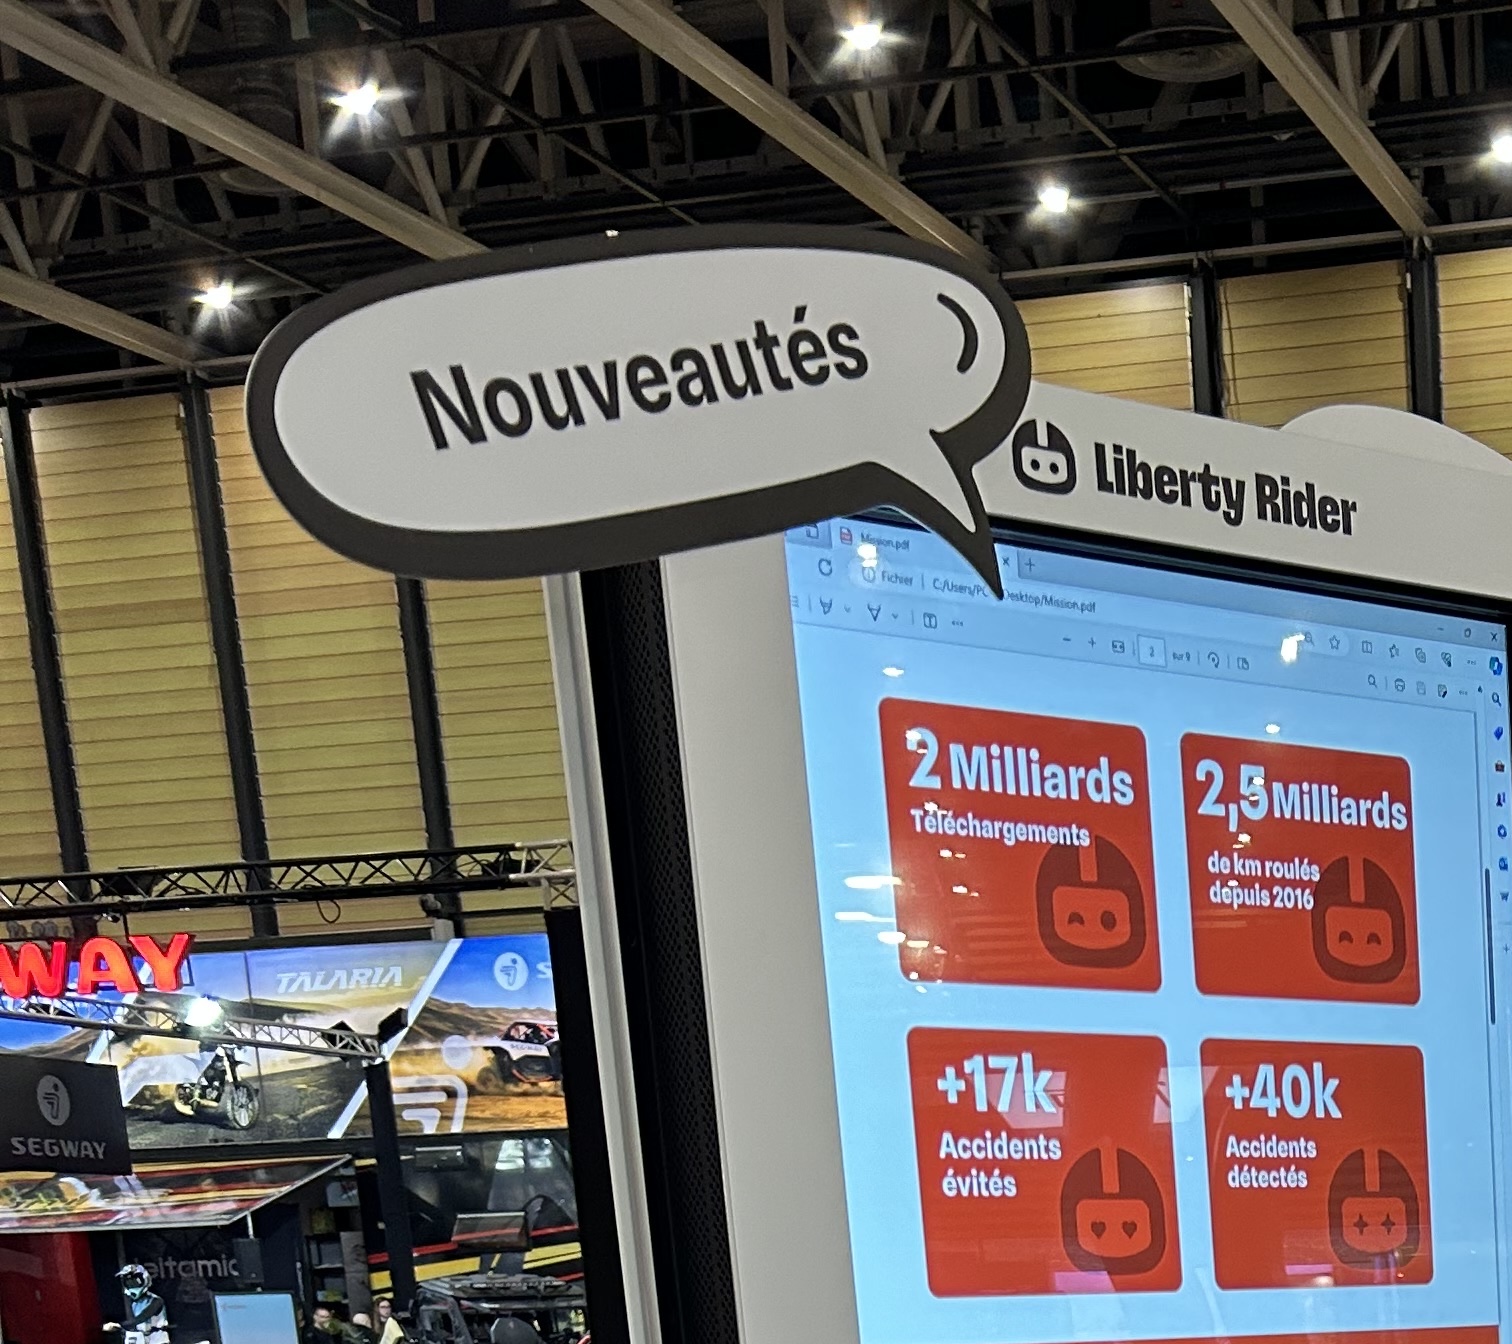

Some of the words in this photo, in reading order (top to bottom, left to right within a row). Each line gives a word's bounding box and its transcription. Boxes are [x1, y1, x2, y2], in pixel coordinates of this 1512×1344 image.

[408, 304, 870, 450] Nouveautés
[1094, 442, 1246, 527] Liberty
[1254, 472, 1357, 535] Rider
[906, 727, 942, 789] 2
[949, 744, 1135, 806] Milliards
[1196, 758, 1269, 832] 2,5
[1272, 781, 1408, 831] Milliards
[909, 806, 1091, 847] Téléchargements
[1207, 851, 1231, 874] de
[1233, 852, 1262, 877] km
[1265, 857, 1321, 882] roulés
[1209, 880, 1271, 911] depuis
[1272, 885, 1315, 911] 2016
[276, 965, 403, 994] TALARIA
[937, 1052, 1057, 1115] +17k
[1225, 1061, 1343, 1120] +40k
[11, 1136, 107, 1161] SEGWAY
[939, 1131, 1062, 1161] Accidents
[1226, 1134, 1318, 1159] Accidents
[942, 1167, 1018, 1198] évités
[1227, 1165, 1309, 1190] détectés
[134, 1252, 241, 1279] eltamic
